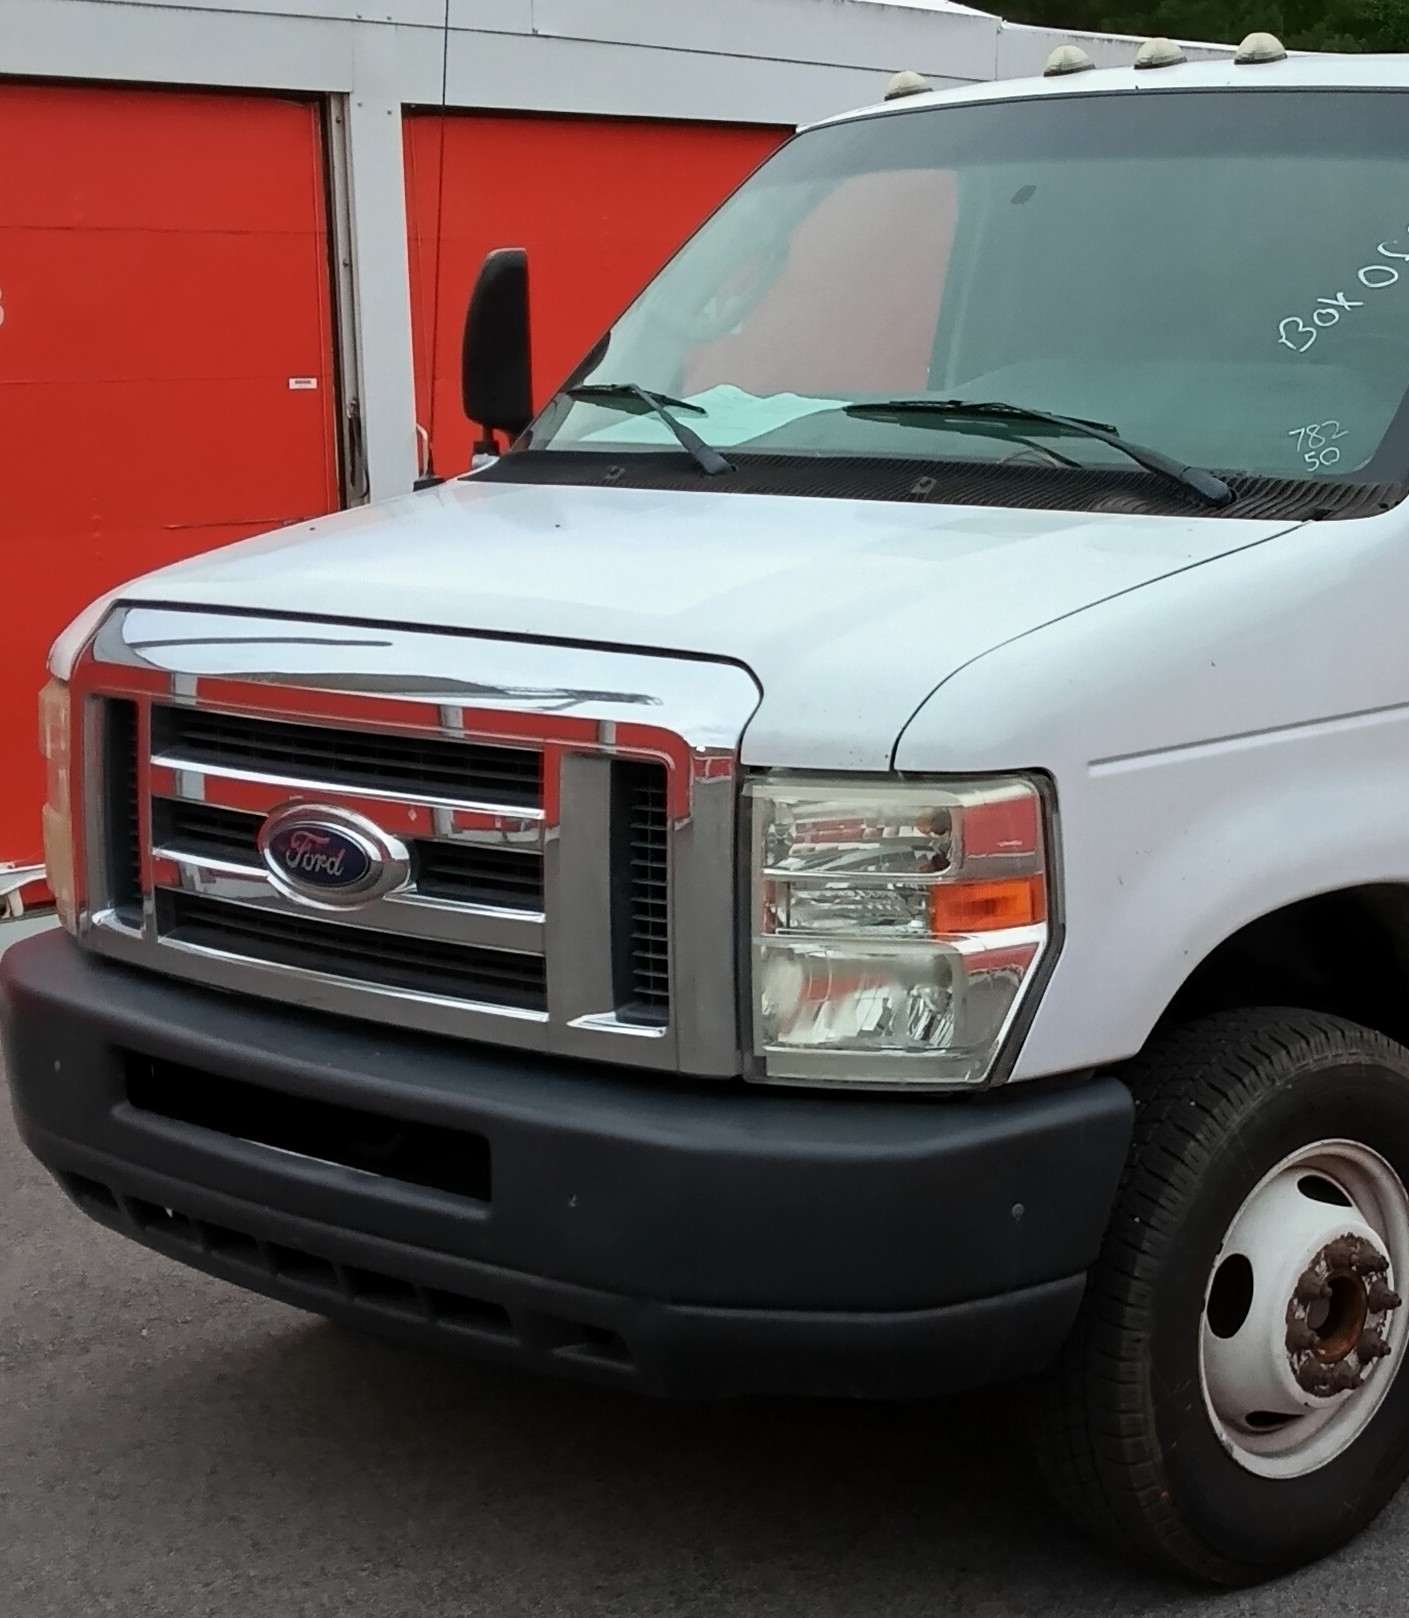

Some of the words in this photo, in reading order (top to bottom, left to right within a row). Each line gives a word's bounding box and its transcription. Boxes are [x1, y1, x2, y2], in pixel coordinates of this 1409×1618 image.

[1278, 292, 1364, 352] Box
[1288, 420, 1349, 452] 782
[1304, 447, 1340, 471] 50
[285, 831, 346, 876] Ford
